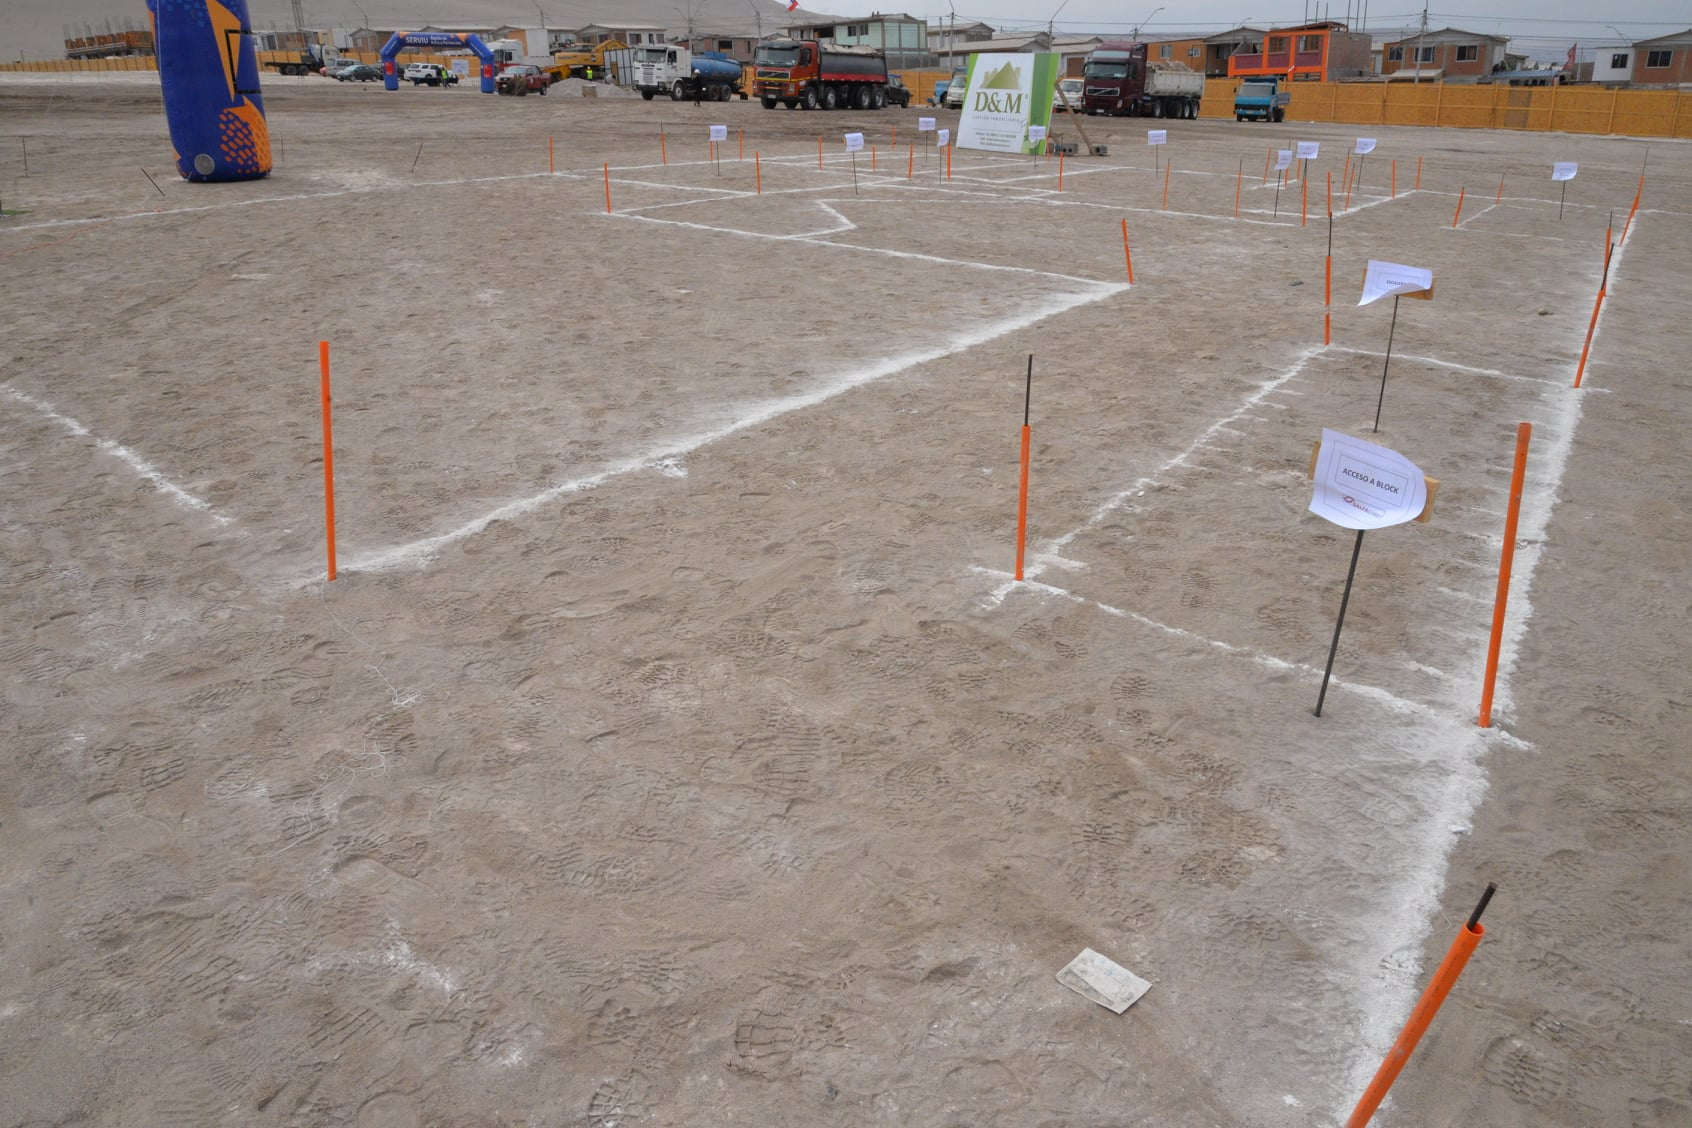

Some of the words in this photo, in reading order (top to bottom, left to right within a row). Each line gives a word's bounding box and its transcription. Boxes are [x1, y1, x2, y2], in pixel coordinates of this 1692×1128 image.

[405, 36, 428, 44] SERVIU
[974, 92, 1023, 114] D&M
[1342, 468, 1369, 483] ACCESO
[1369, 478, 1375, 486] A
[1376, 480, 1400, 494] BLOCK
